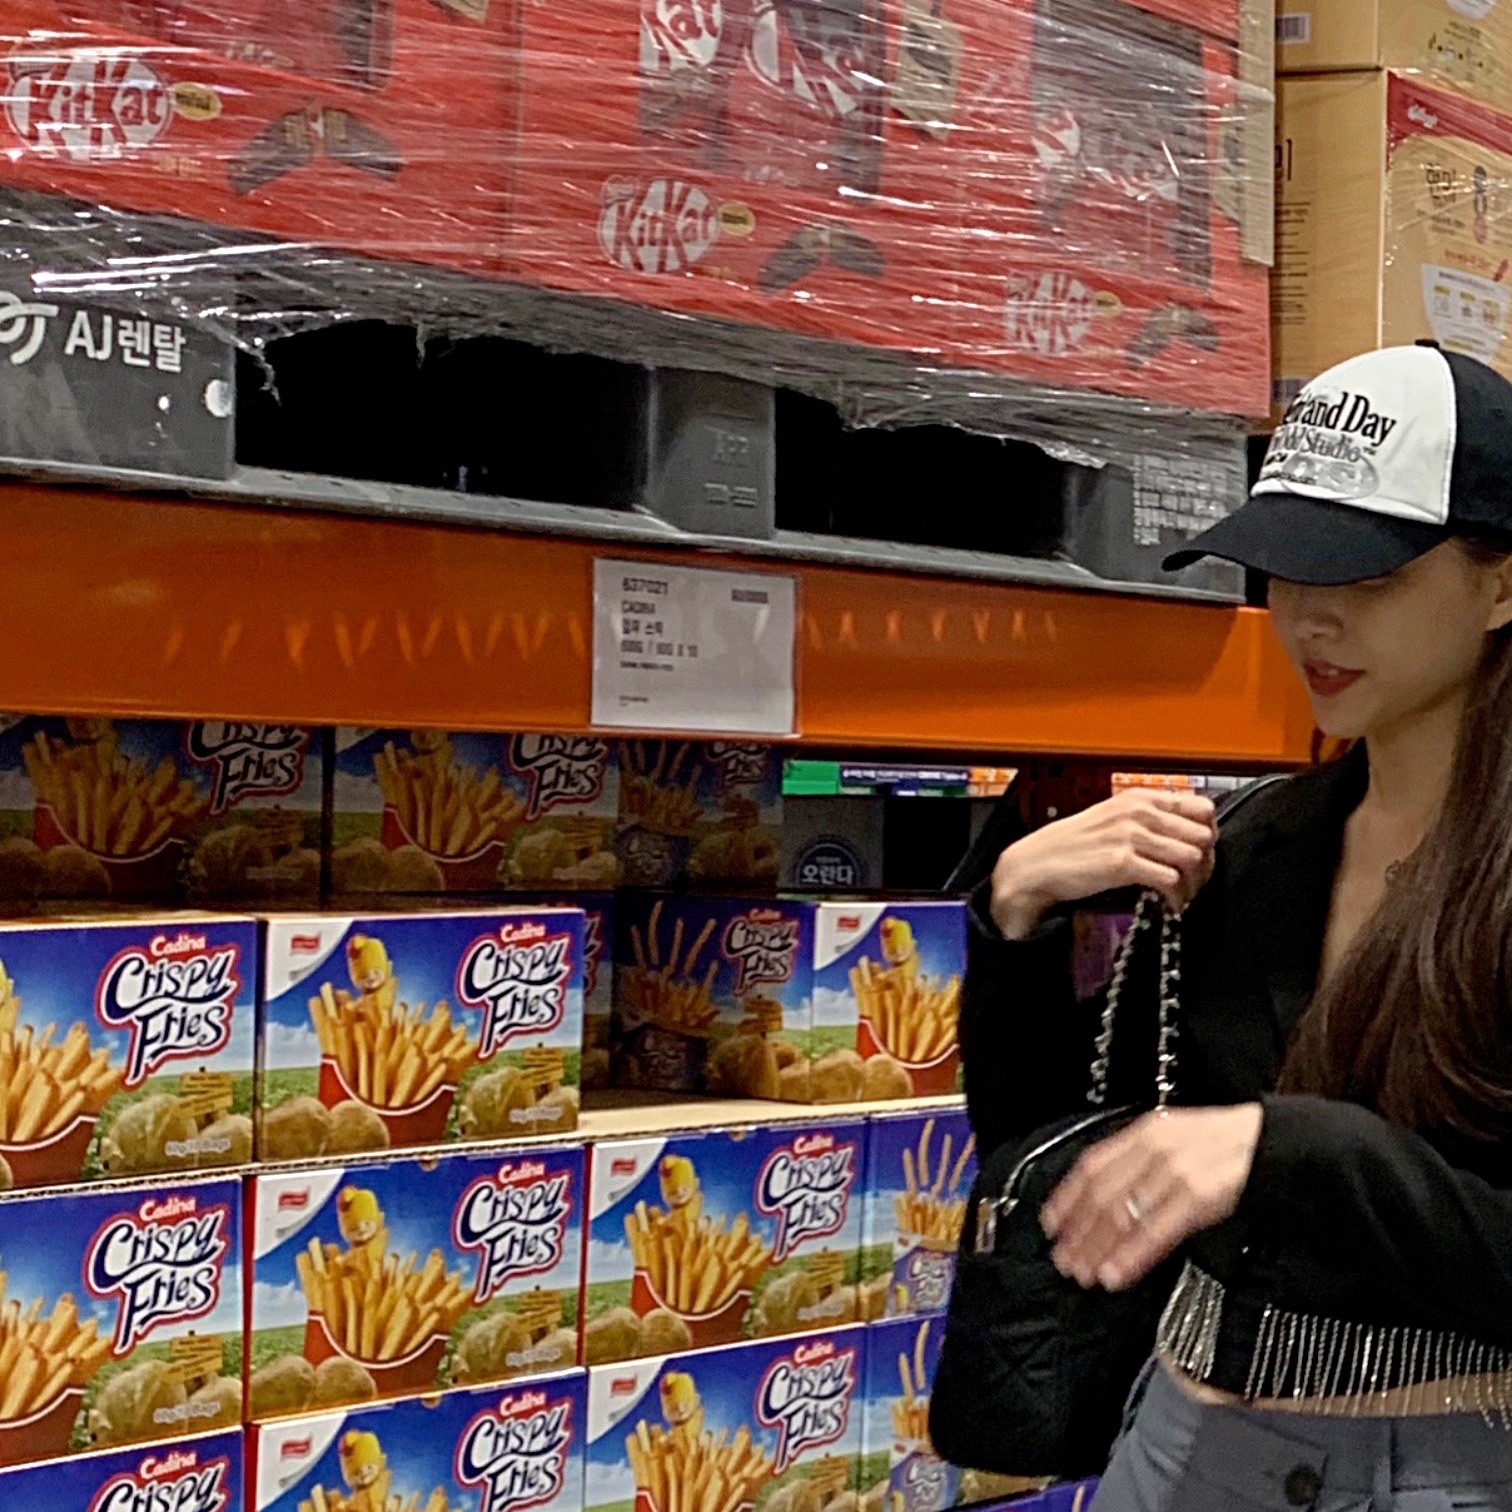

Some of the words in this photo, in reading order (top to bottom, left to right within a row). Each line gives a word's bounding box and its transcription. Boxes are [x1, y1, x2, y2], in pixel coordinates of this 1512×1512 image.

[64, 312, 186, 373] AJ렌탈
[1341, 394, 1396, 447] Day
[211, 747, 296, 812] Fries
[529, 764, 598, 817] Fries
[801, 864, 853, 885] 오란다
[150, 935, 206, 956] Cadina
[465, 940, 568, 998] Crispy
[105, 952, 236, 1022] Crispy
[126, 1007, 226, 1082] Fries
[480, 985, 556, 1056] Fries
[763, 1148, 852, 1203] Crispy
[140, 1198, 196, 1221] Cadina
[459, 1179, 565, 1241] Crispy
[775, 1195, 840, 1262] Fries
[93, 1211, 225, 1291] Crispy
[475, 1222, 561, 1301] Fries
[115, 1266, 214, 1353] Fries
[761, 1352, 852, 1413] Crispy
[141, 1453, 197, 1478] Cadina
[459, 1408, 565, 1482] Crispy
[776, 1405, 841, 1474] Fries
